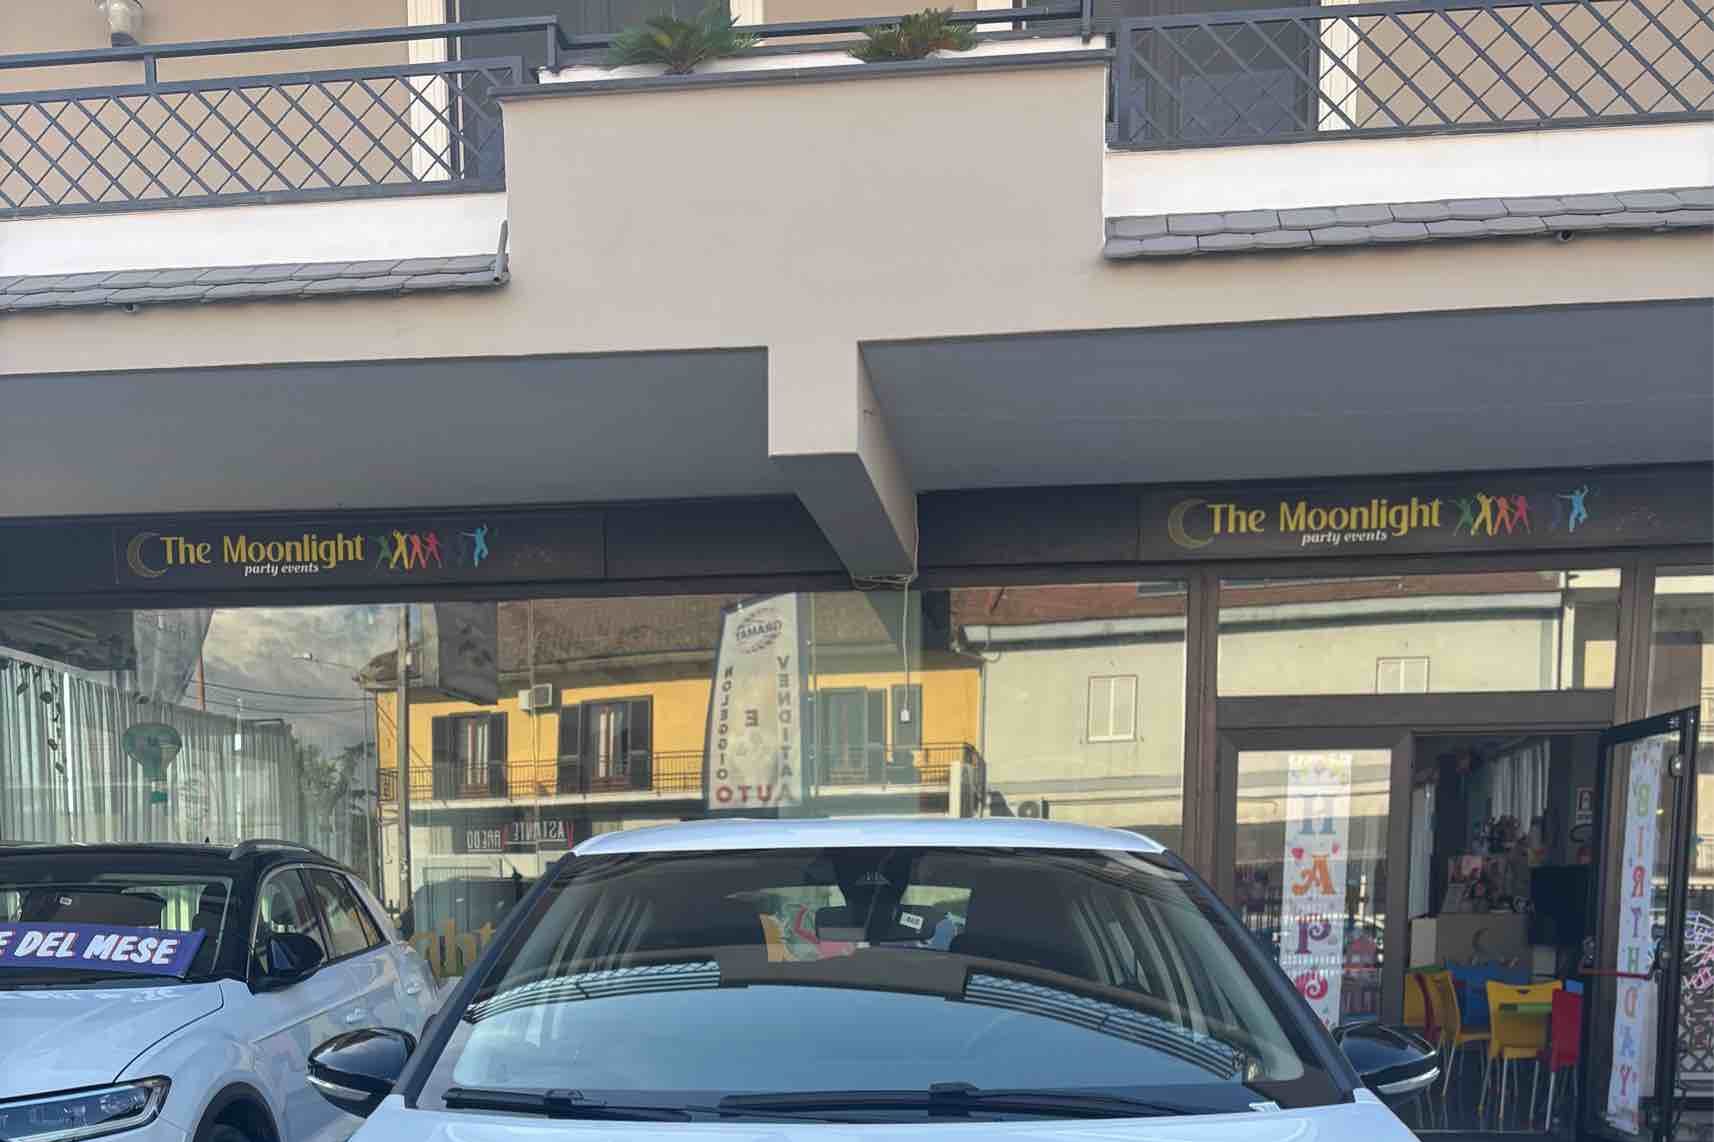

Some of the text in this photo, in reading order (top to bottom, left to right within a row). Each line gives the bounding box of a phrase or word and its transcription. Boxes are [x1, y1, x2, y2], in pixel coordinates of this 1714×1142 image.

[1207, 497, 1443, 536] The Moonlight
[160, 532, 365, 569] The Moonlight
[1301, 529, 1388, 546] party events
[244, 561, 319, 577] party events
[14, 930, 77, 958] DEL
[82, 934, 179, 965] MESE
